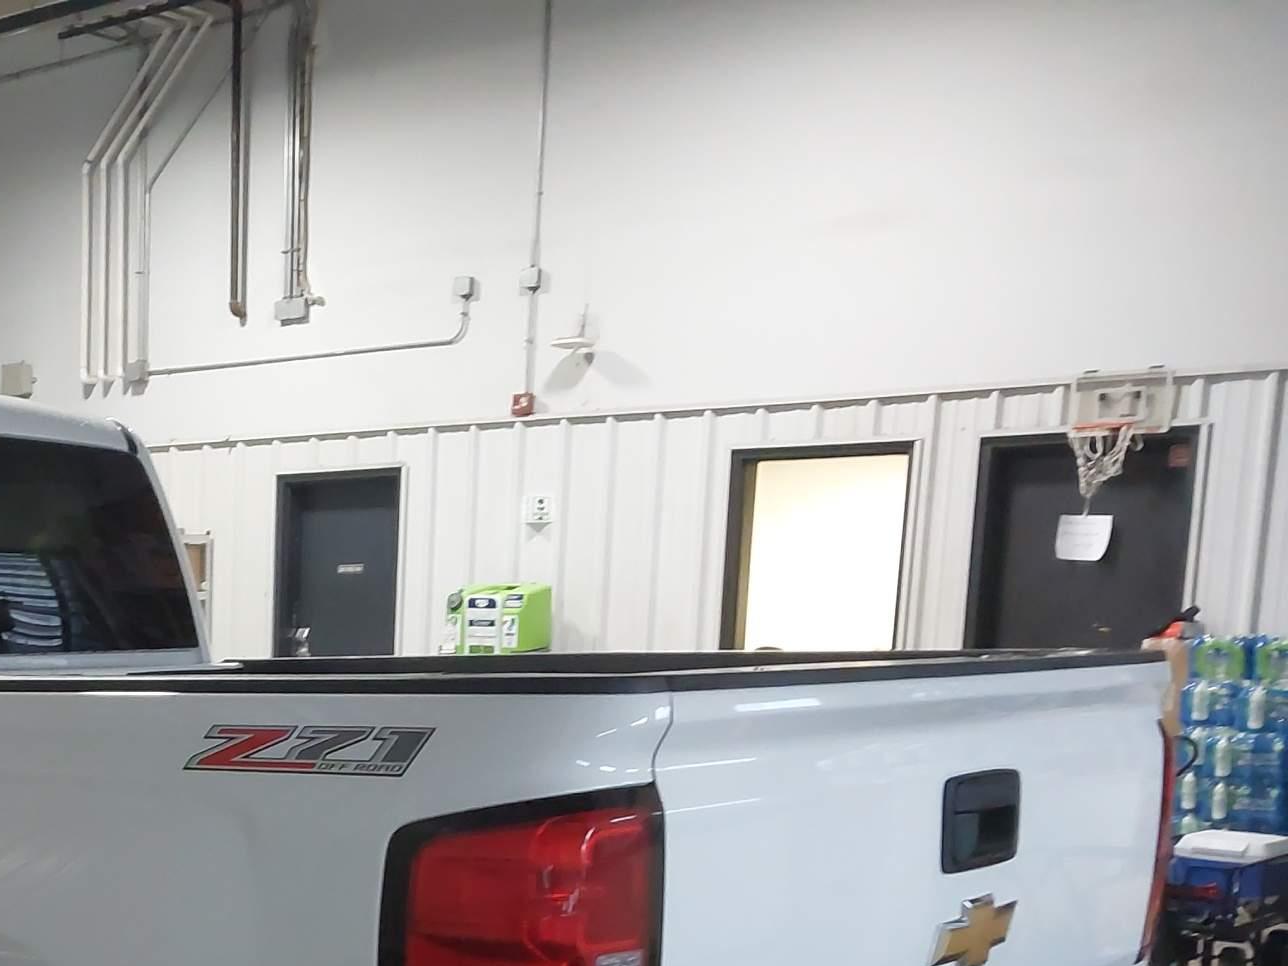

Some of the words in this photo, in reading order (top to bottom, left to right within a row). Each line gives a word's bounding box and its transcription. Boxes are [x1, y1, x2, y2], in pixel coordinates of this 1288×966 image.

[186, 725, 434, 774] Z71
[317, 762, 349, 771] OFF
[353, 763, 404, 772] ROAD
